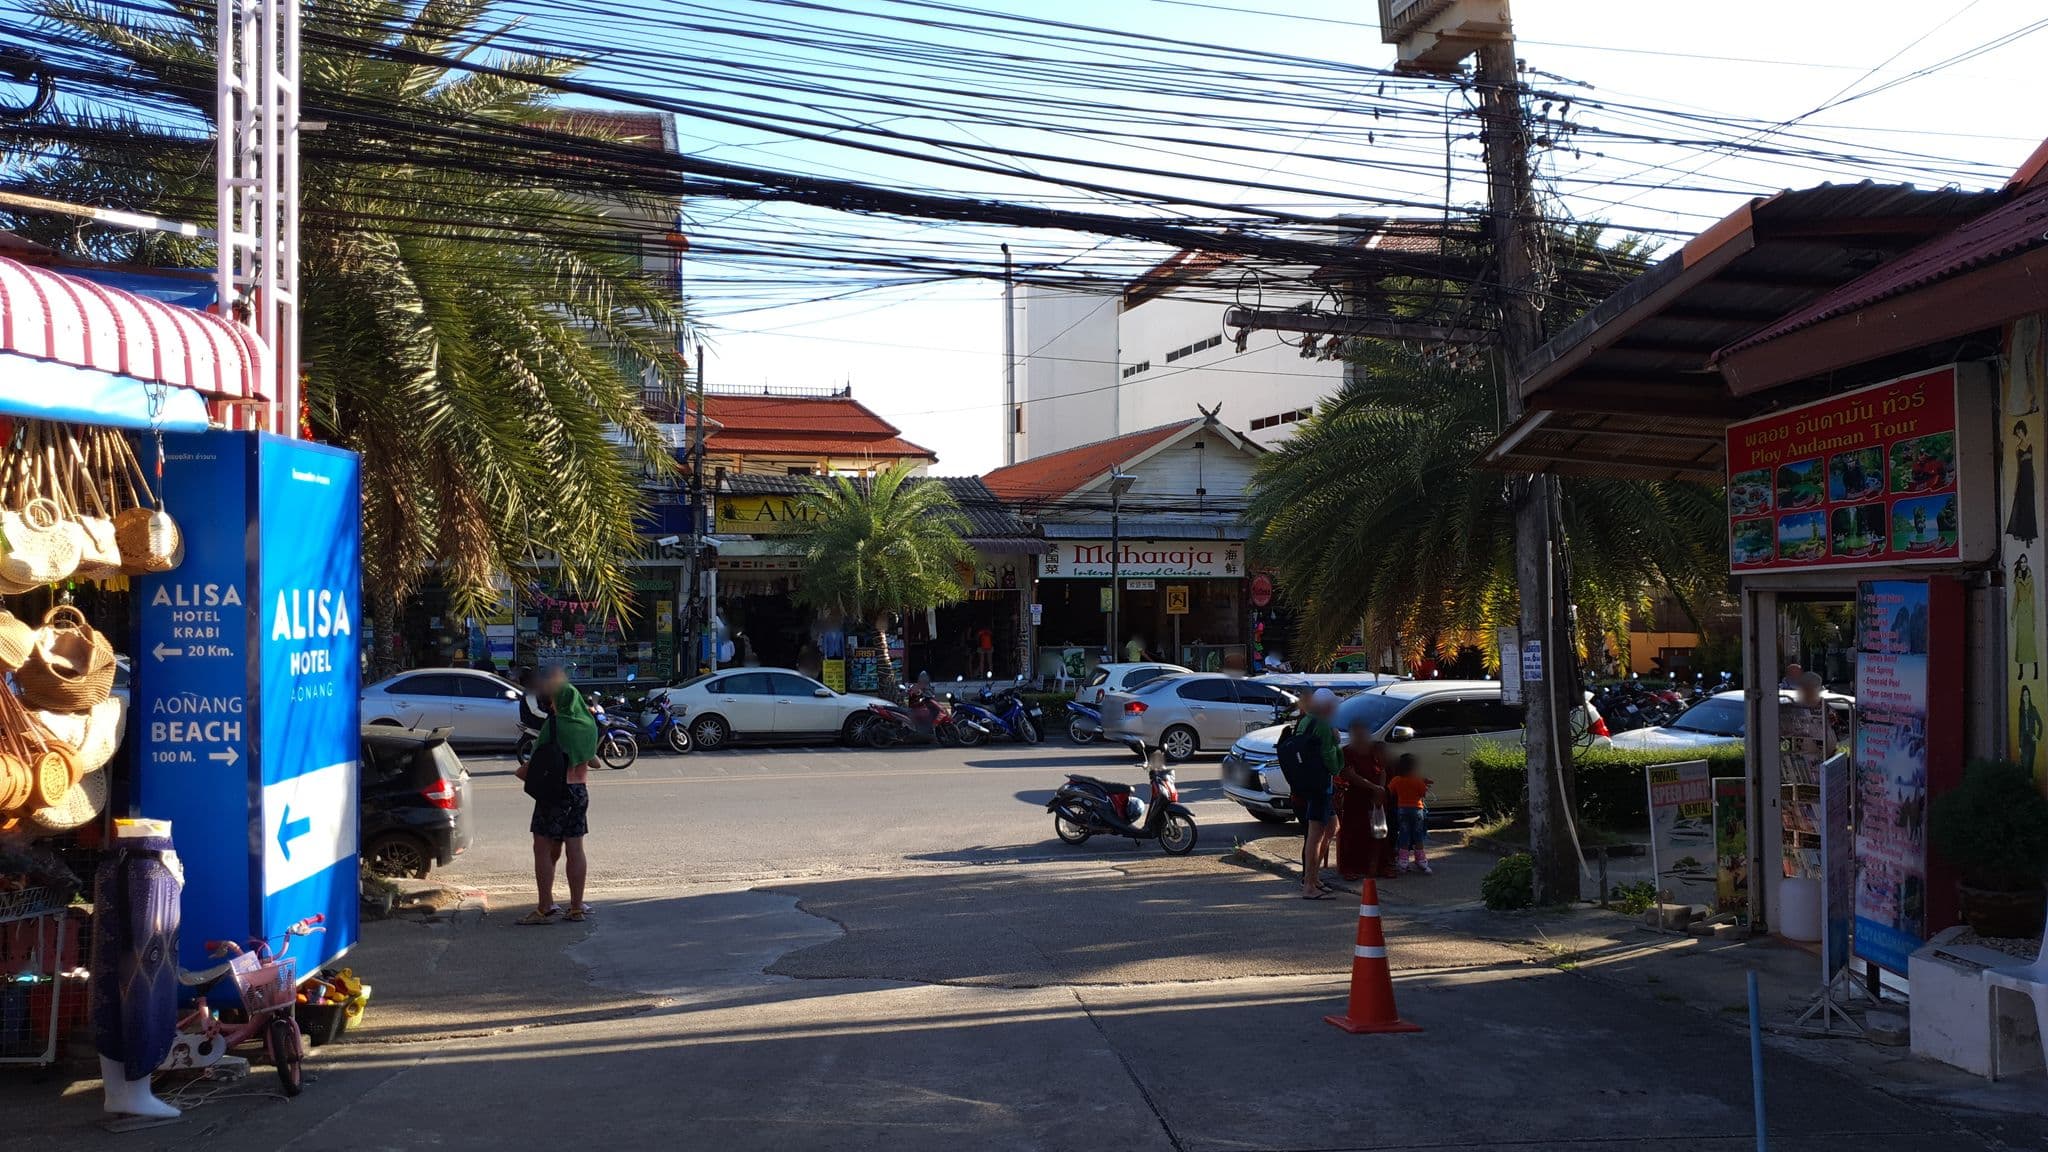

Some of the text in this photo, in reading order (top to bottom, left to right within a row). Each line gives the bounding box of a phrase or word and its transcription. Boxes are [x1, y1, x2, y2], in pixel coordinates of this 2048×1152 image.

[1745, 382, 1926, 448] พลอย อันดามัน ทัวร์
[1751, 419, 1919, 465] Ploy Andaman Tour
[1073, 544, 1214, 570] Maharaja
[1074, 567, 1212, 577] Interntional Cuisine
[152, 584, 242, 606] ALISA
[173, 611, 220, 622] HOTEL
[271, 589, 350, 641] ALISA
[174, 627, 219, 638] KRABI
[188, 645, 234, 657] 20 Km.
[290, 650, 332, 676] HOTEL
[291, 681, 333, 703] AONANG
[1866, 689, 1880, 698] Tiger
[153, 697, 242, 713] AONANG
[152, 721, 240, 742] BEACH
[152, 751, 196, 763] 100 M.
[1651, 770, 1679, 783] PRIVATE
[1653, 786, 1681, 802] SPEED
[1684, 803, 1711, 817] RENTAL
